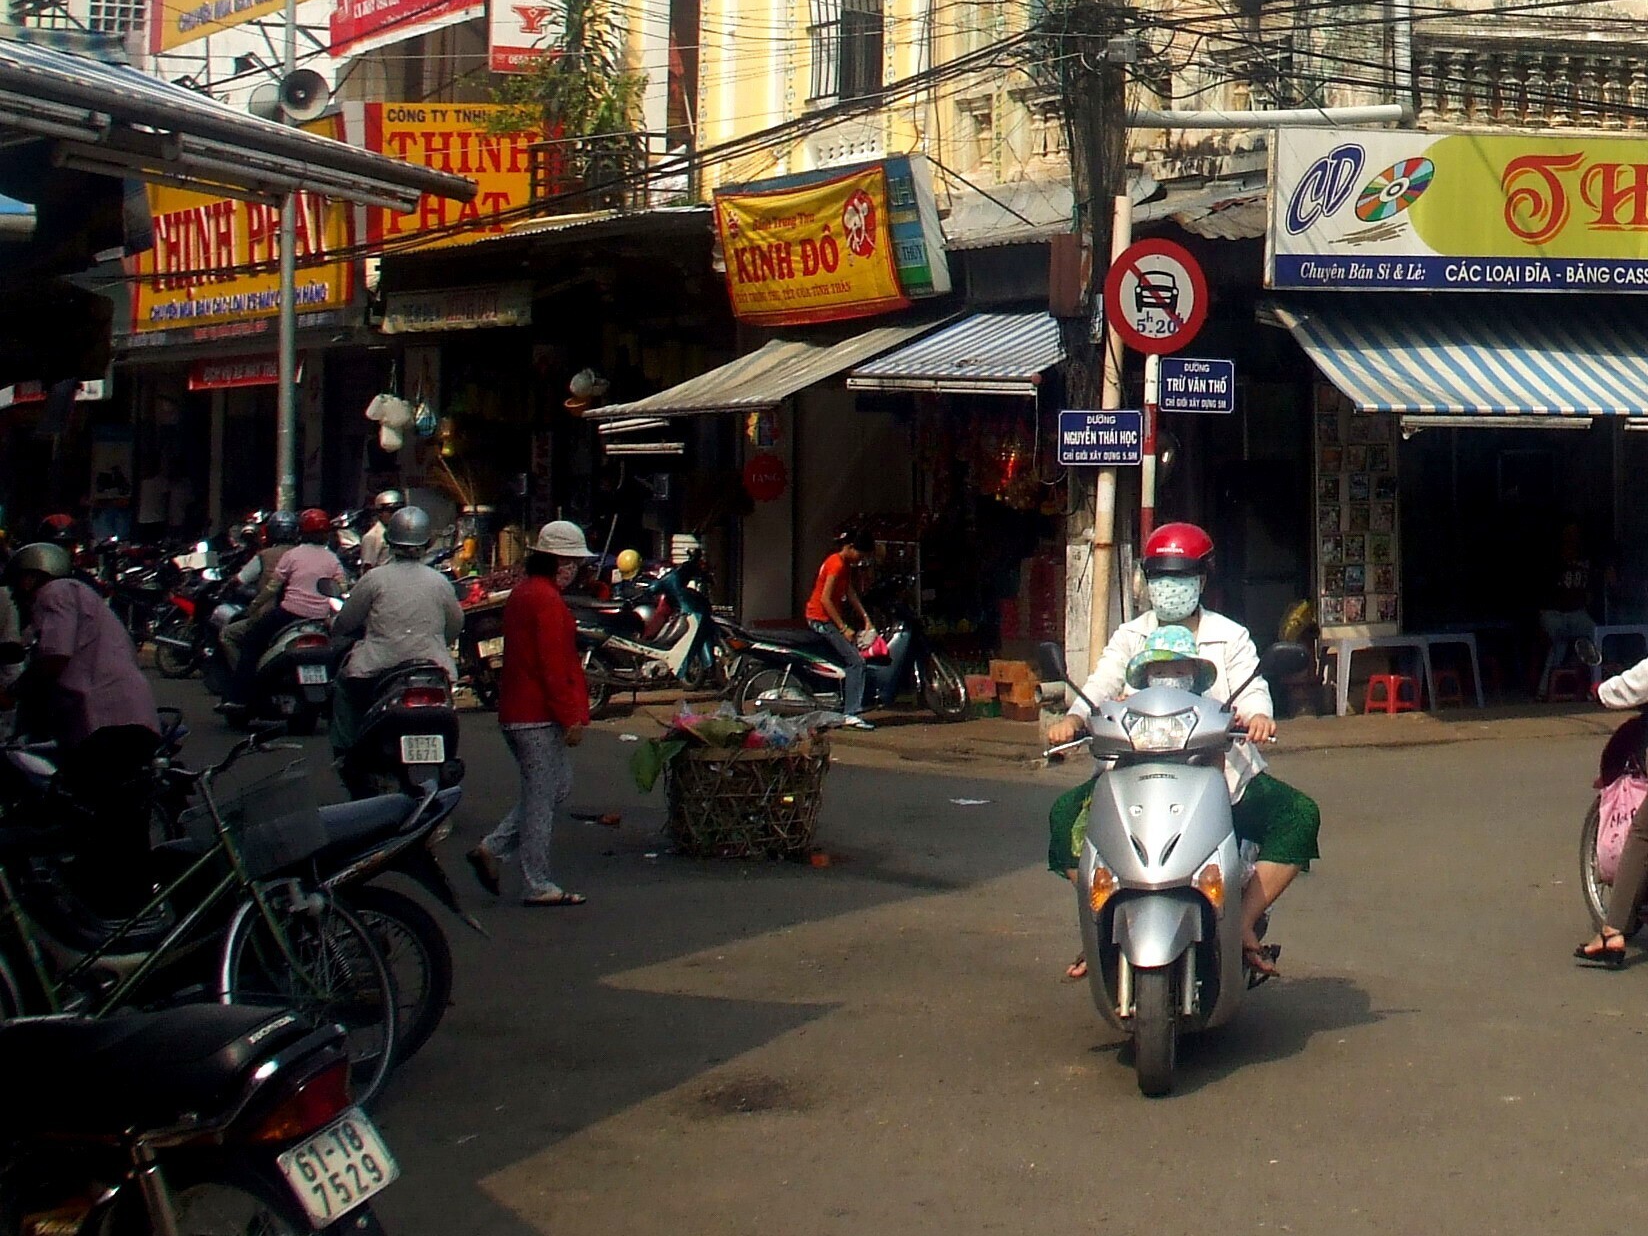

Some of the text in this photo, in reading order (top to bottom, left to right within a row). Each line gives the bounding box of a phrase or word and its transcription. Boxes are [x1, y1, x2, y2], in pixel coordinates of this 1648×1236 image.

[387, 107, 426, 123] CÔNG
[431, 109, 449, 123] TY
[1285, 142, 1367, 235] CD
[734, 224, 839, 284] KINH ĐÔ
[1300, 262, 1345, 283] Chuyên
[1348, 262, 1373, 280] Bán
[1393, 266, 1404, 280] &
[1445, 260, 1480, 282] CÁC
[1486, 266, 1520, 288] LOẠI
[1525, 261, 1551, 283] ĐĨA
[1566, 262, 1610, 284] BĂNG
[1187, 376, 1206, 393] VĂN
[1063, 425, 1138, 448] NGUYỄN THÁI HỌC
[312, 1153, 385, 1217] 7529
